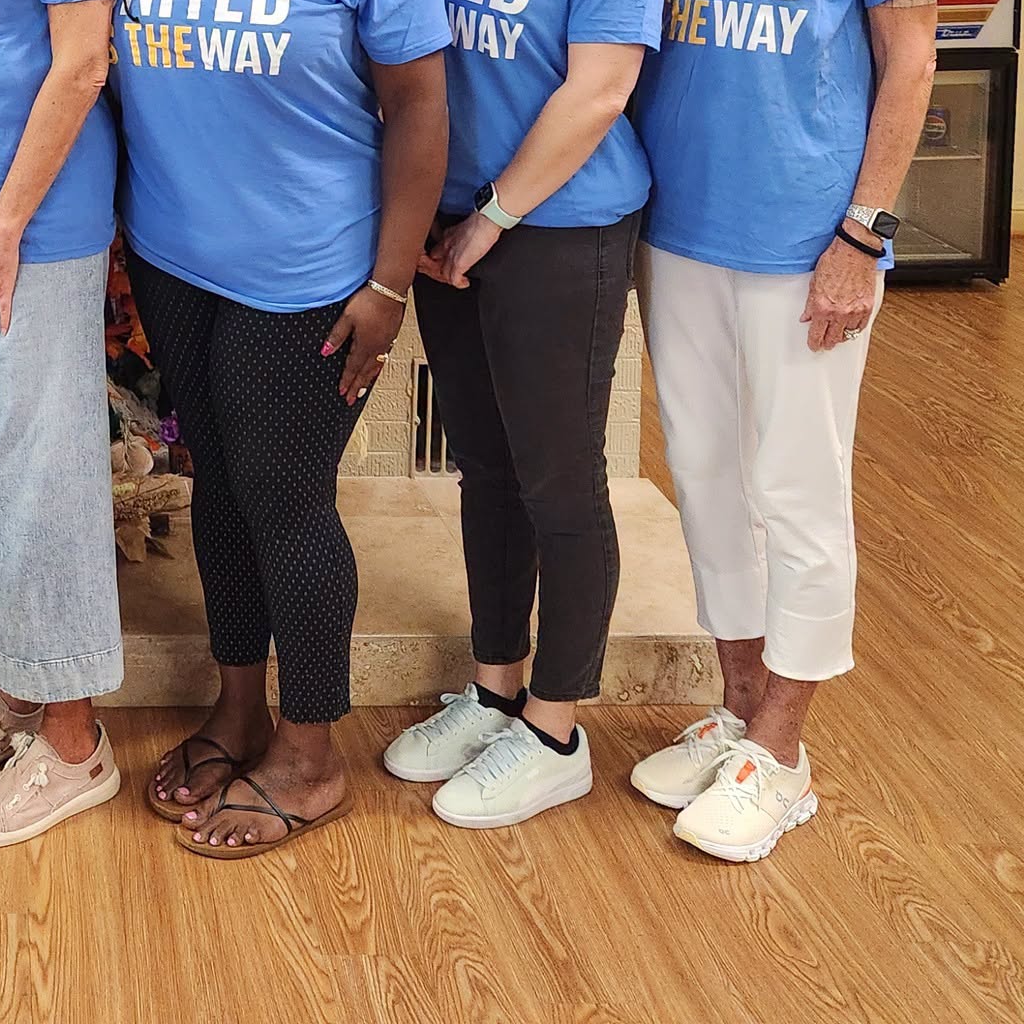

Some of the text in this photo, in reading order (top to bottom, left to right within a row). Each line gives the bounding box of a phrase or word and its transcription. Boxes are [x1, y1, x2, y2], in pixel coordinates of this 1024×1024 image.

[124, 22, 292, 76] THE WAY
[448, 2, 524, 60] WAY
[713, 0, 809, 55] WAY
